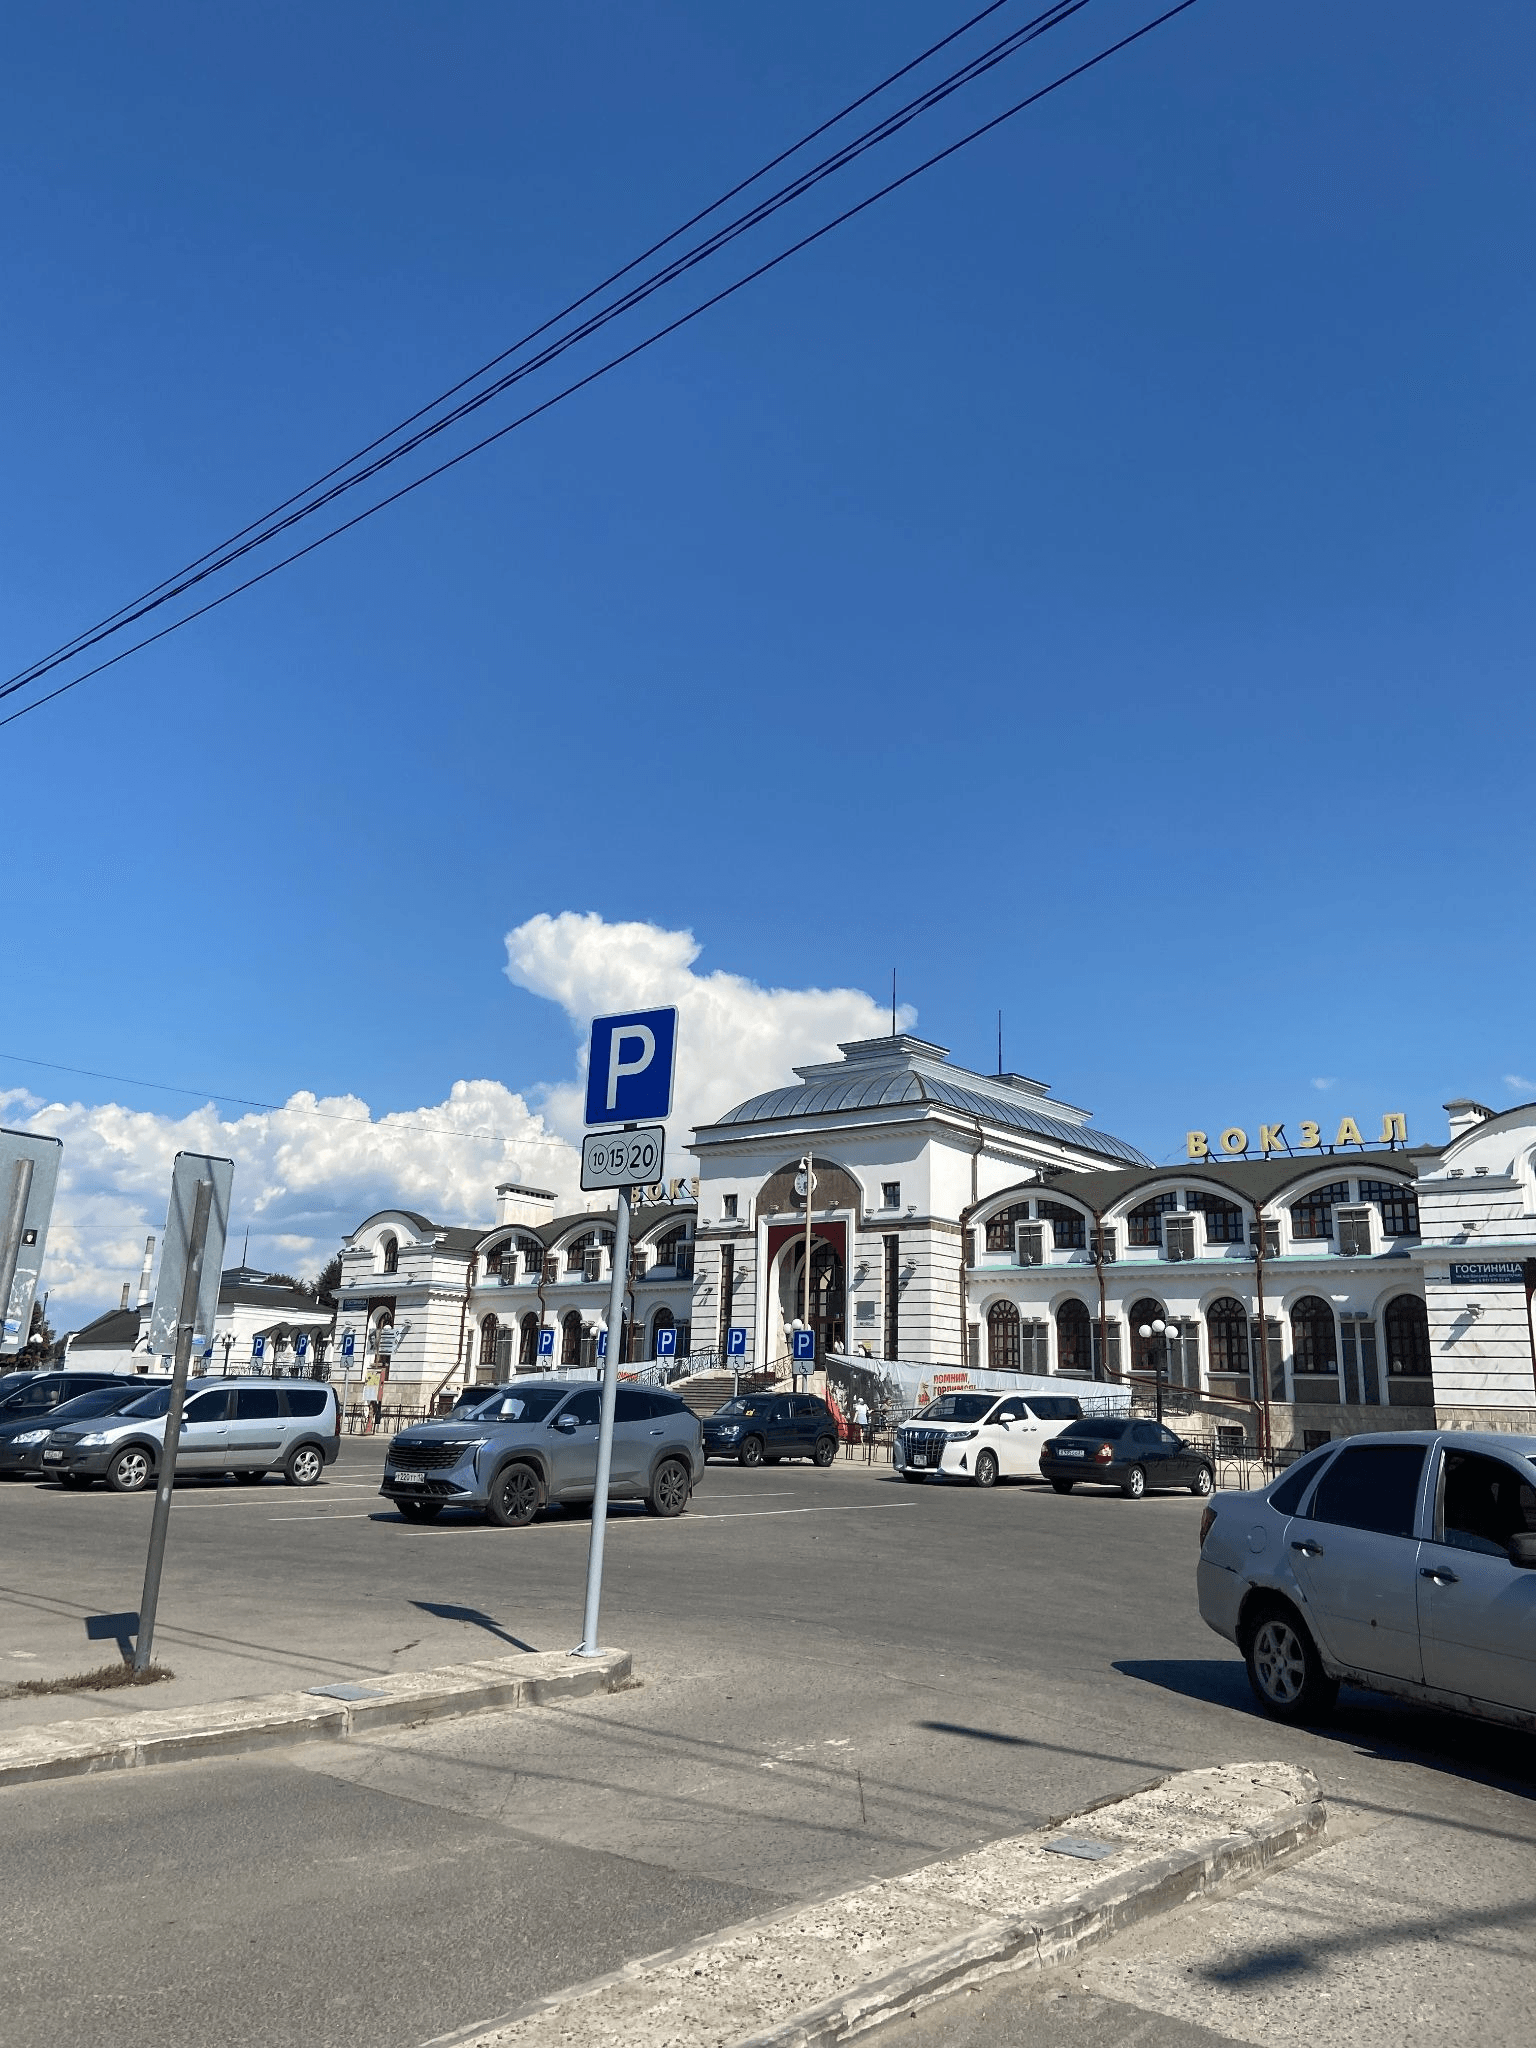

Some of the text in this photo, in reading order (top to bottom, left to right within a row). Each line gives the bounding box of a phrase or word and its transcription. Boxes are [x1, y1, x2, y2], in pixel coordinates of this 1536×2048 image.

[606, 1024, 656, 1110] P
[1187, 1113, 1408, 1158] ВОКЗАЛ
[593, 1144, 654, 1168] 10 15 20
[1455, 1263, 1523, 1274] ГОСТИНИЦА
[254, 1338, 263, 1354] P
[298, 1337, 307, 1353] P
[344, 1336, 353, 1354] P
[541, 1333, 551, 1352] P
[661, 1331, 672, 1352] P
[731, 1331, 743, 1352] P
[798, 1333, 810, 1355] P
